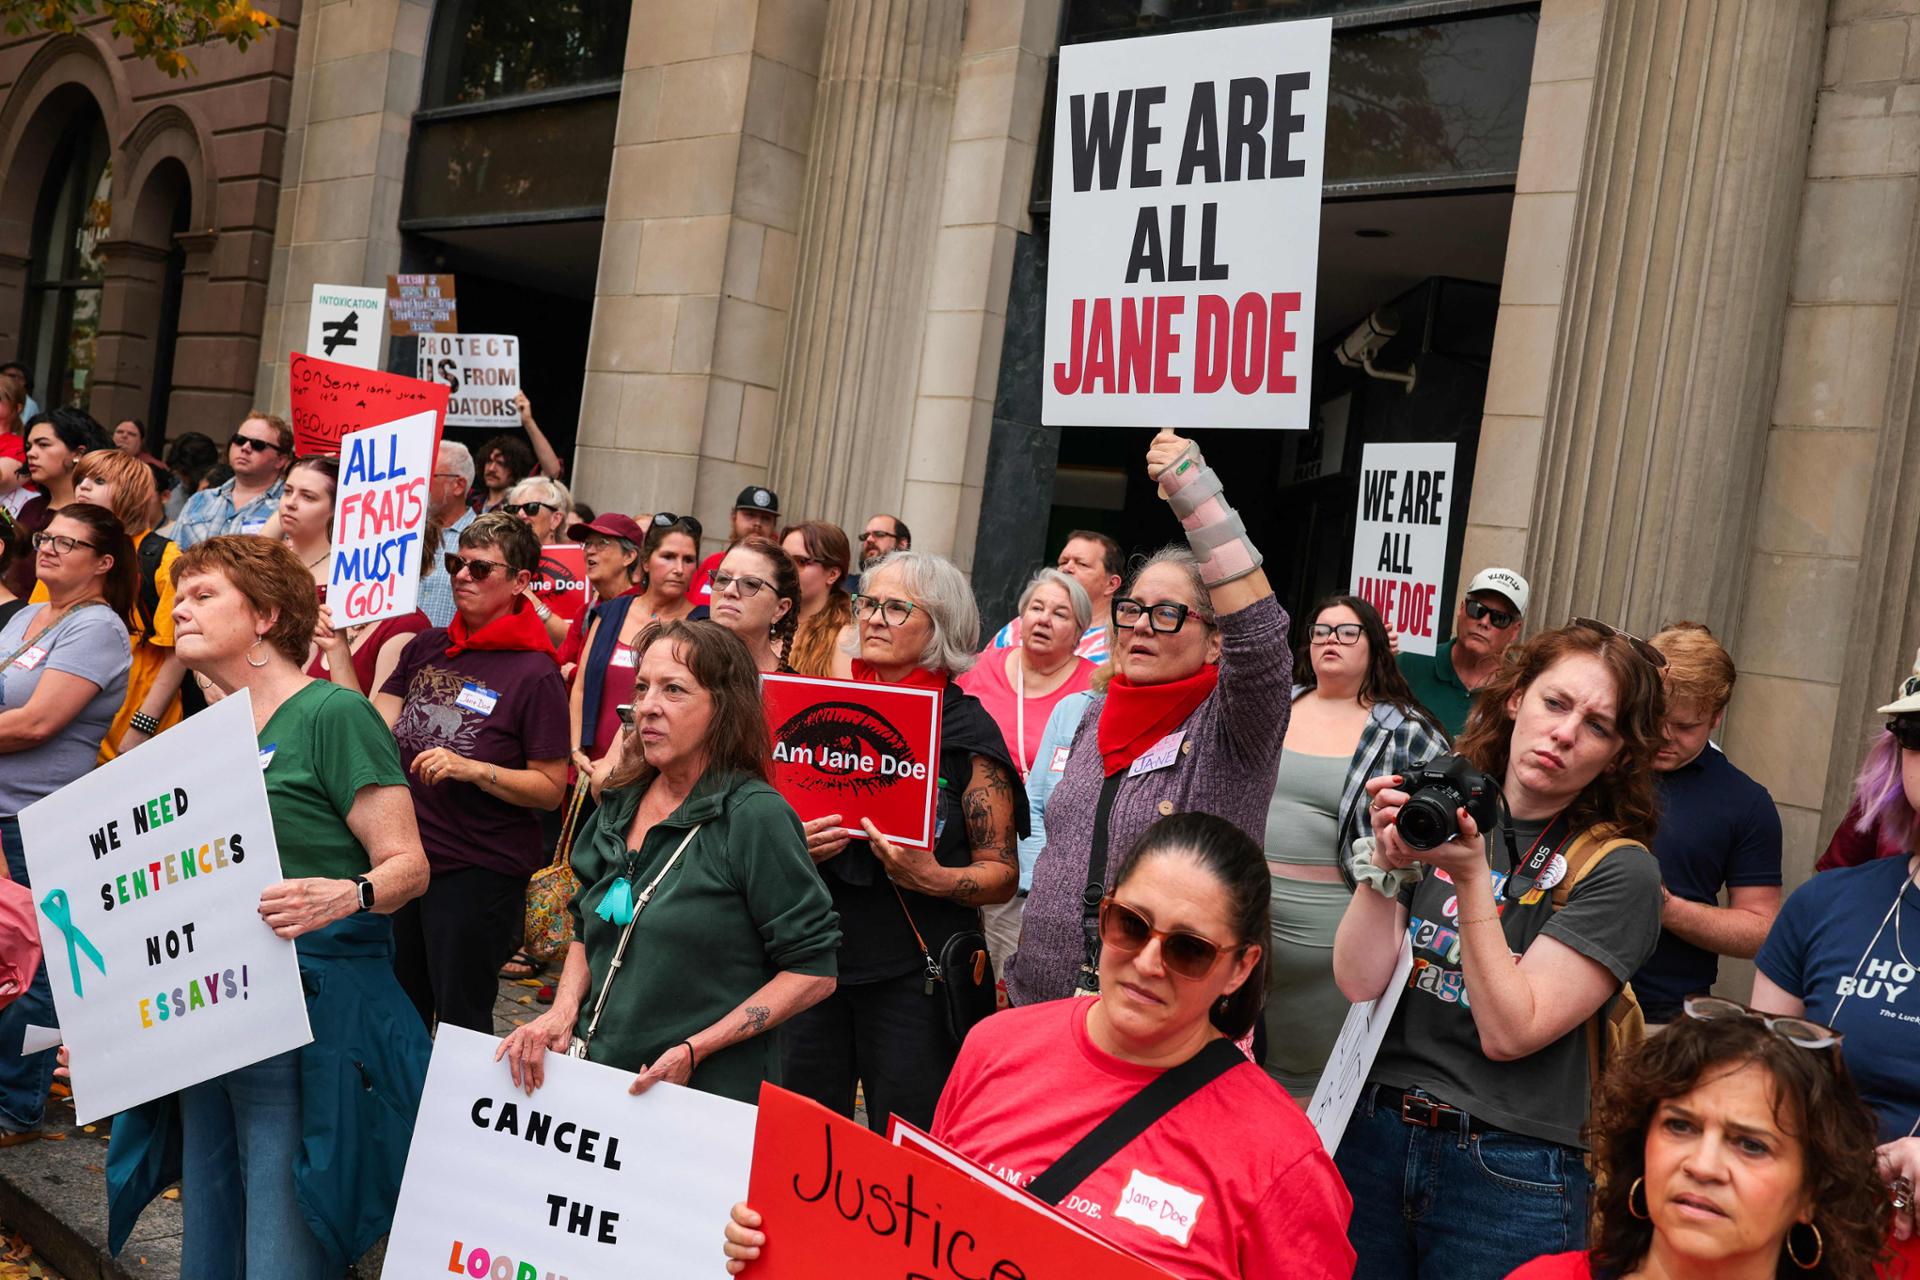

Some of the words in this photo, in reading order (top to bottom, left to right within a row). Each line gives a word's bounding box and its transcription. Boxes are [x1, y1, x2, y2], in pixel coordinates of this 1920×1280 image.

[1070, 86, 1166, 192] WE
[1176, 71, 1311, 185] ARE
[1124, 202, 1229, 284] ALL
[319, 295, 378, 309] INTOXICATION
[419, 336, 515, 357] PROTECT
[1053, 296, 1185, 395] JANE
[1193, 291, 1302, 394] DOE
[292, 358, 360, 391] Consent
[418, 358, 460, 394] US
[463, 367, 516, 386] FROM
[448, 397, 517, 417] DATORS
[343, 433, 407, 486] ALL
[338, 476, 426, 545] FRATS
[1363, 469, 1397, 523] WE
[1398, 470, 1446, 526] ARE
[332, 532, 418, 586] MUST
[1377, 532, 1413, 575] ALL
[345, 573, 396, 619] GO!
[529, 580, 552, 591] ne
[555, 579, 585, 591] Doe
[1488, 573, 1520, 591] ATLANTA
[1397, 581, 1436, 638] DOE
[772, 741, 814, 765] Am
[818, 747, 875, 773] Jane
[880, 754, 926, 780] Doe
[1134, 748, 1178, 774] JANE
[89, 820, 121, 860] WE
[132, 787, 188, 835] NEED
[101, 833, 245, 911] SENTENCES
[1530, 845, 1550, 869] EOS
[146, 922, 195, 966] NOT
[138, 964, 248, 1029] ESSAYS!
[1836, 976, 1908, 1003] BUY
[1879, 1009, 1897, 1018] The
[471, 1097, 622, 1171] CANCEL
[547, 1194, 620, 1244] THE
[1066, 1195, 1102, 1219] DOE.
[1125, 1187, 1158, 1212] Jane
[1159, 1200, 1189, 1227] Doe
[448, 1240, 569, 1280] LOOP
